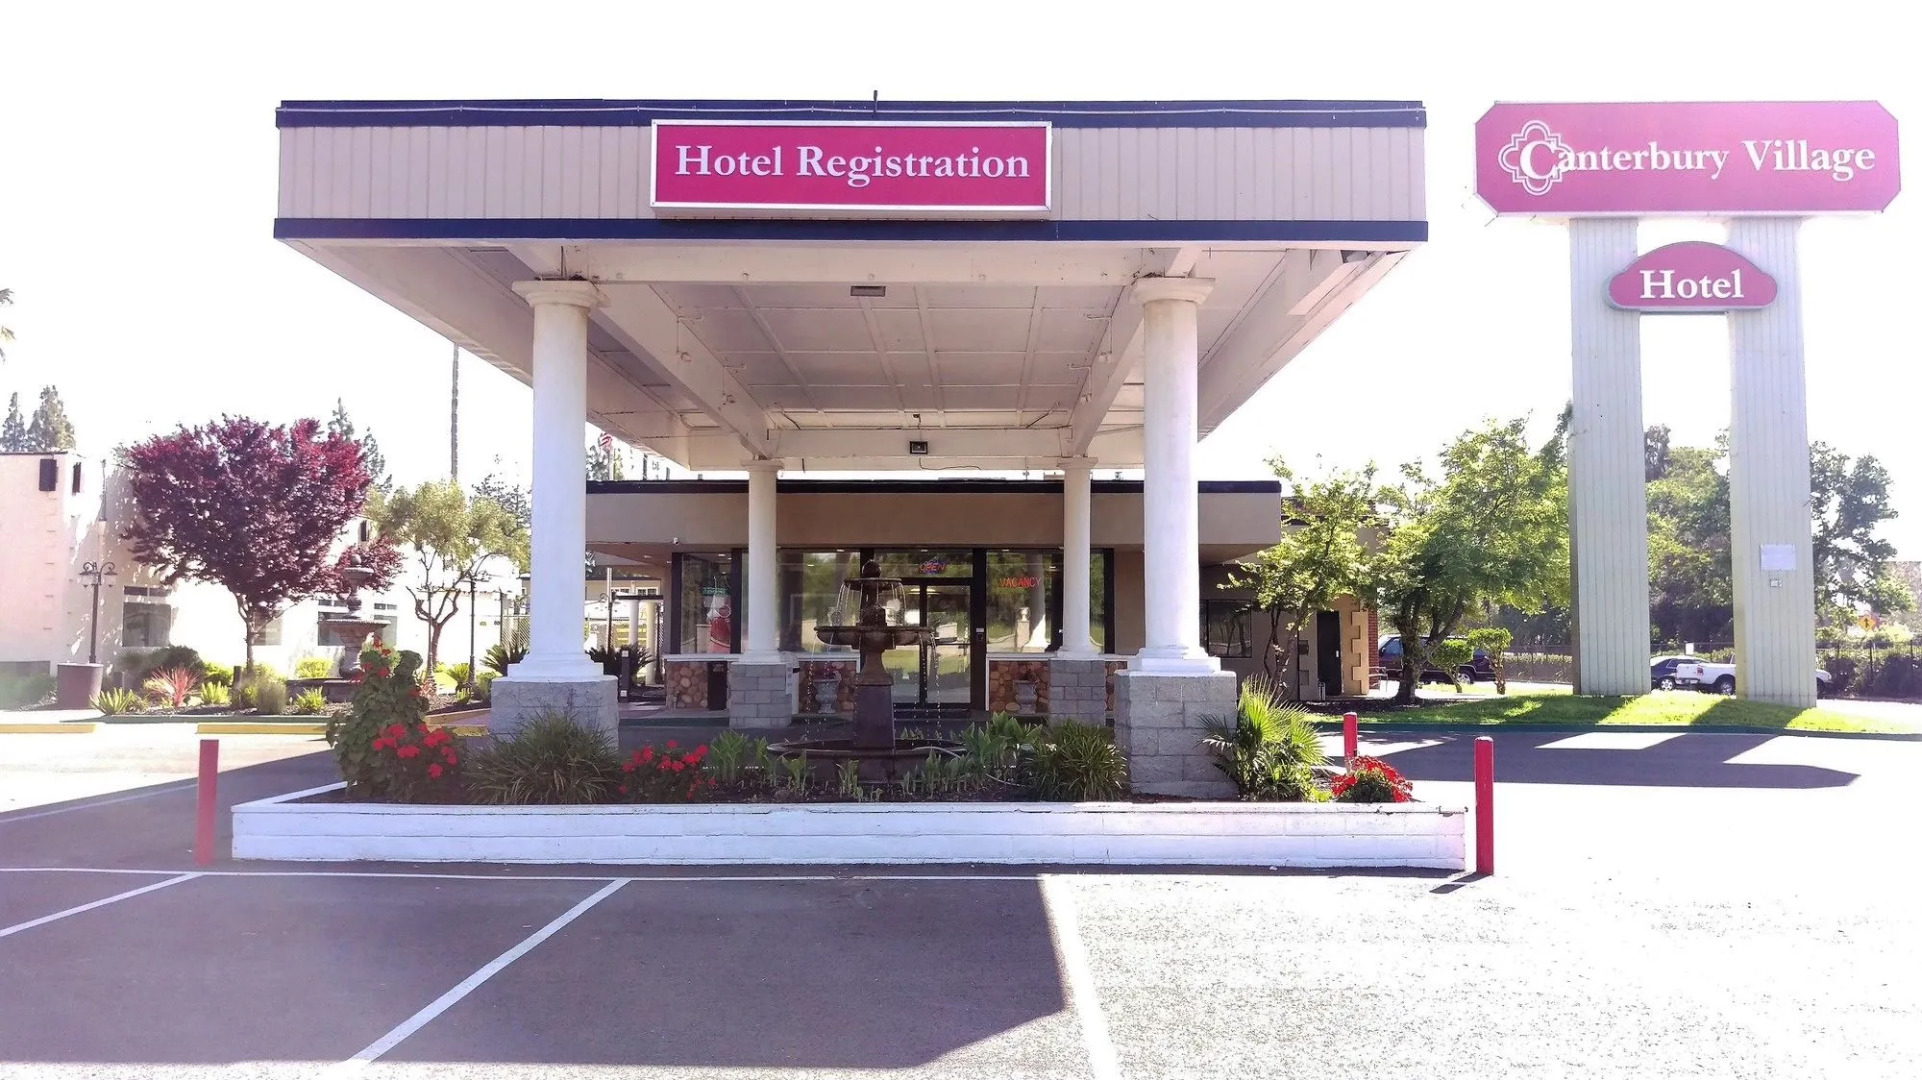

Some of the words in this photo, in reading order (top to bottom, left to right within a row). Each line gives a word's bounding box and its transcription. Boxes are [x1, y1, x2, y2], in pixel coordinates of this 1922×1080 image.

[674, 144, 784, 177] Hotel
[796, 144, 1030, 188] Registration
[1518, 138, 1730, 181] Canterbury
[1741, 138, 1876, 182] Village
[1638, 269, 1745, 299] Hotel
[919, 562, 946, 572] OPEN
[1000, 577, 1042, 588] VACANCY
